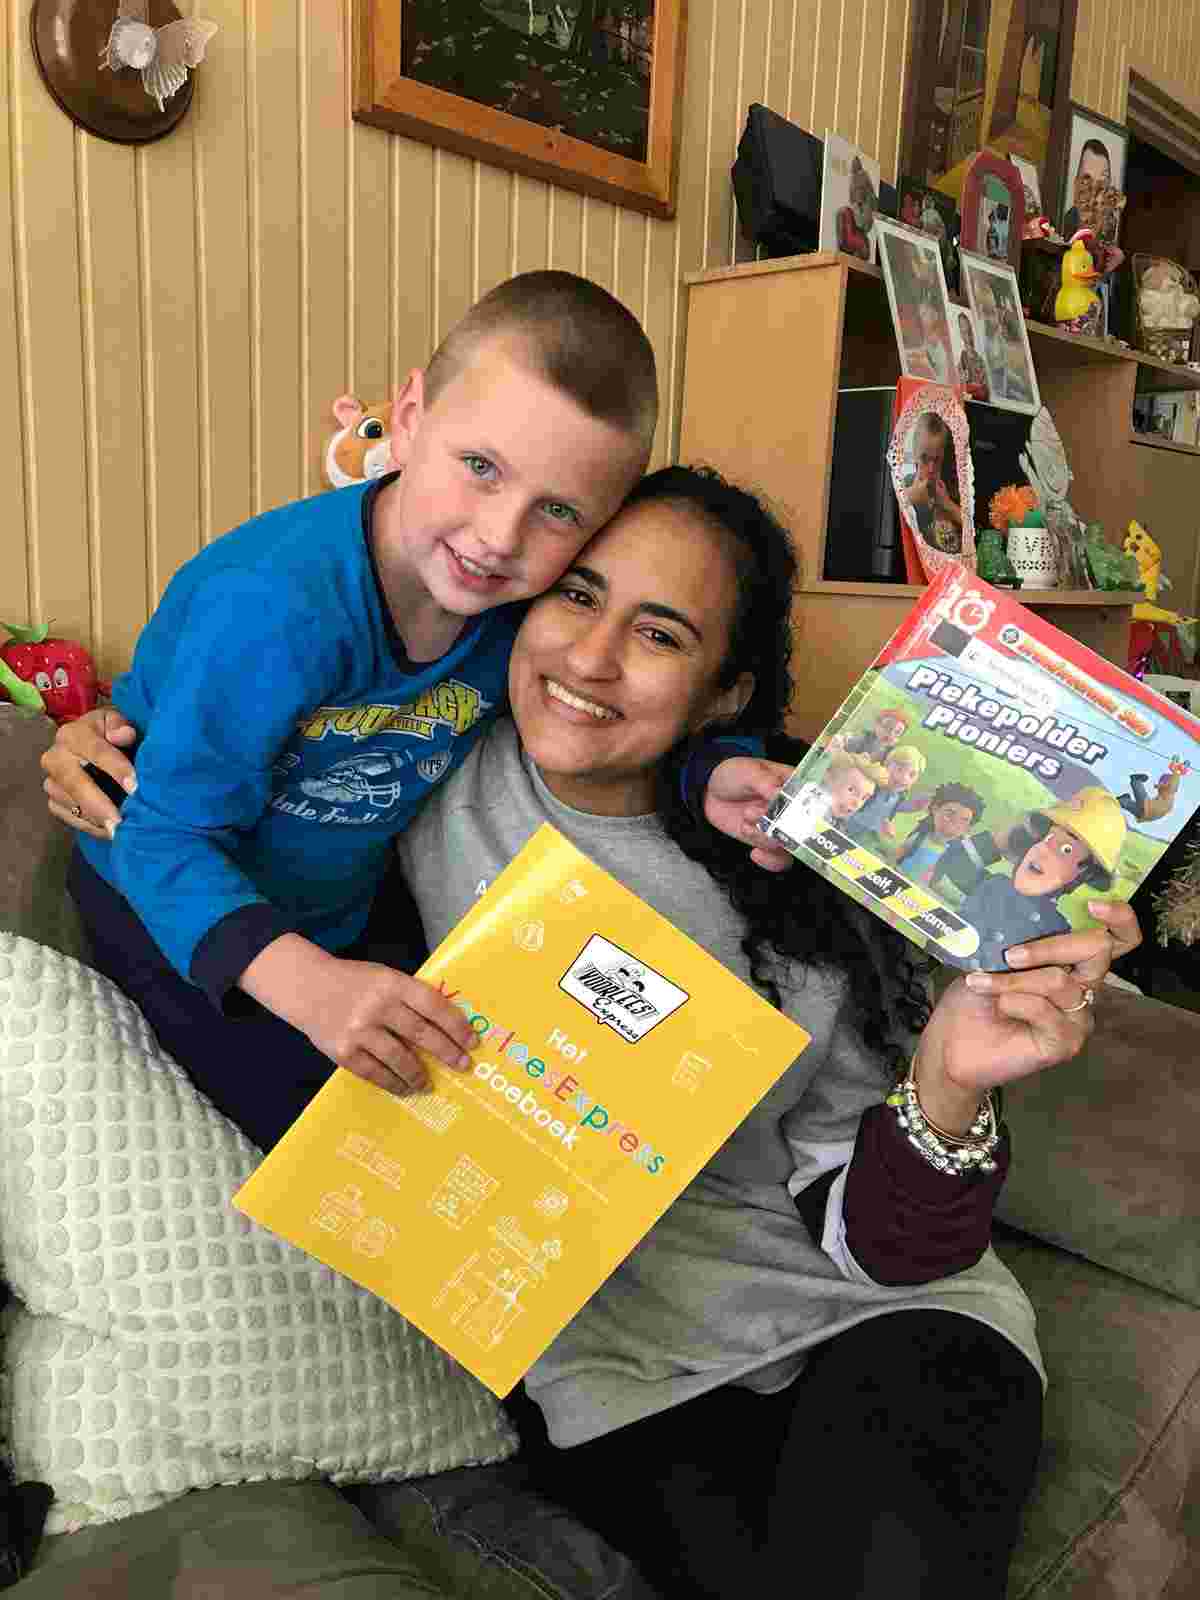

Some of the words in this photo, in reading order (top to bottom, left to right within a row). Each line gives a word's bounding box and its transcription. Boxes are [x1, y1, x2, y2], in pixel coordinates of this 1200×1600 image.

[906, 664, 1109, 765] Piekepolder
[922, 702, 1063, 780] Pioniers
[547, 1025, 589, 1065] Het
[592, 996, 639, 1039] Express
[473, 1058, 578, 1152] doeboek
